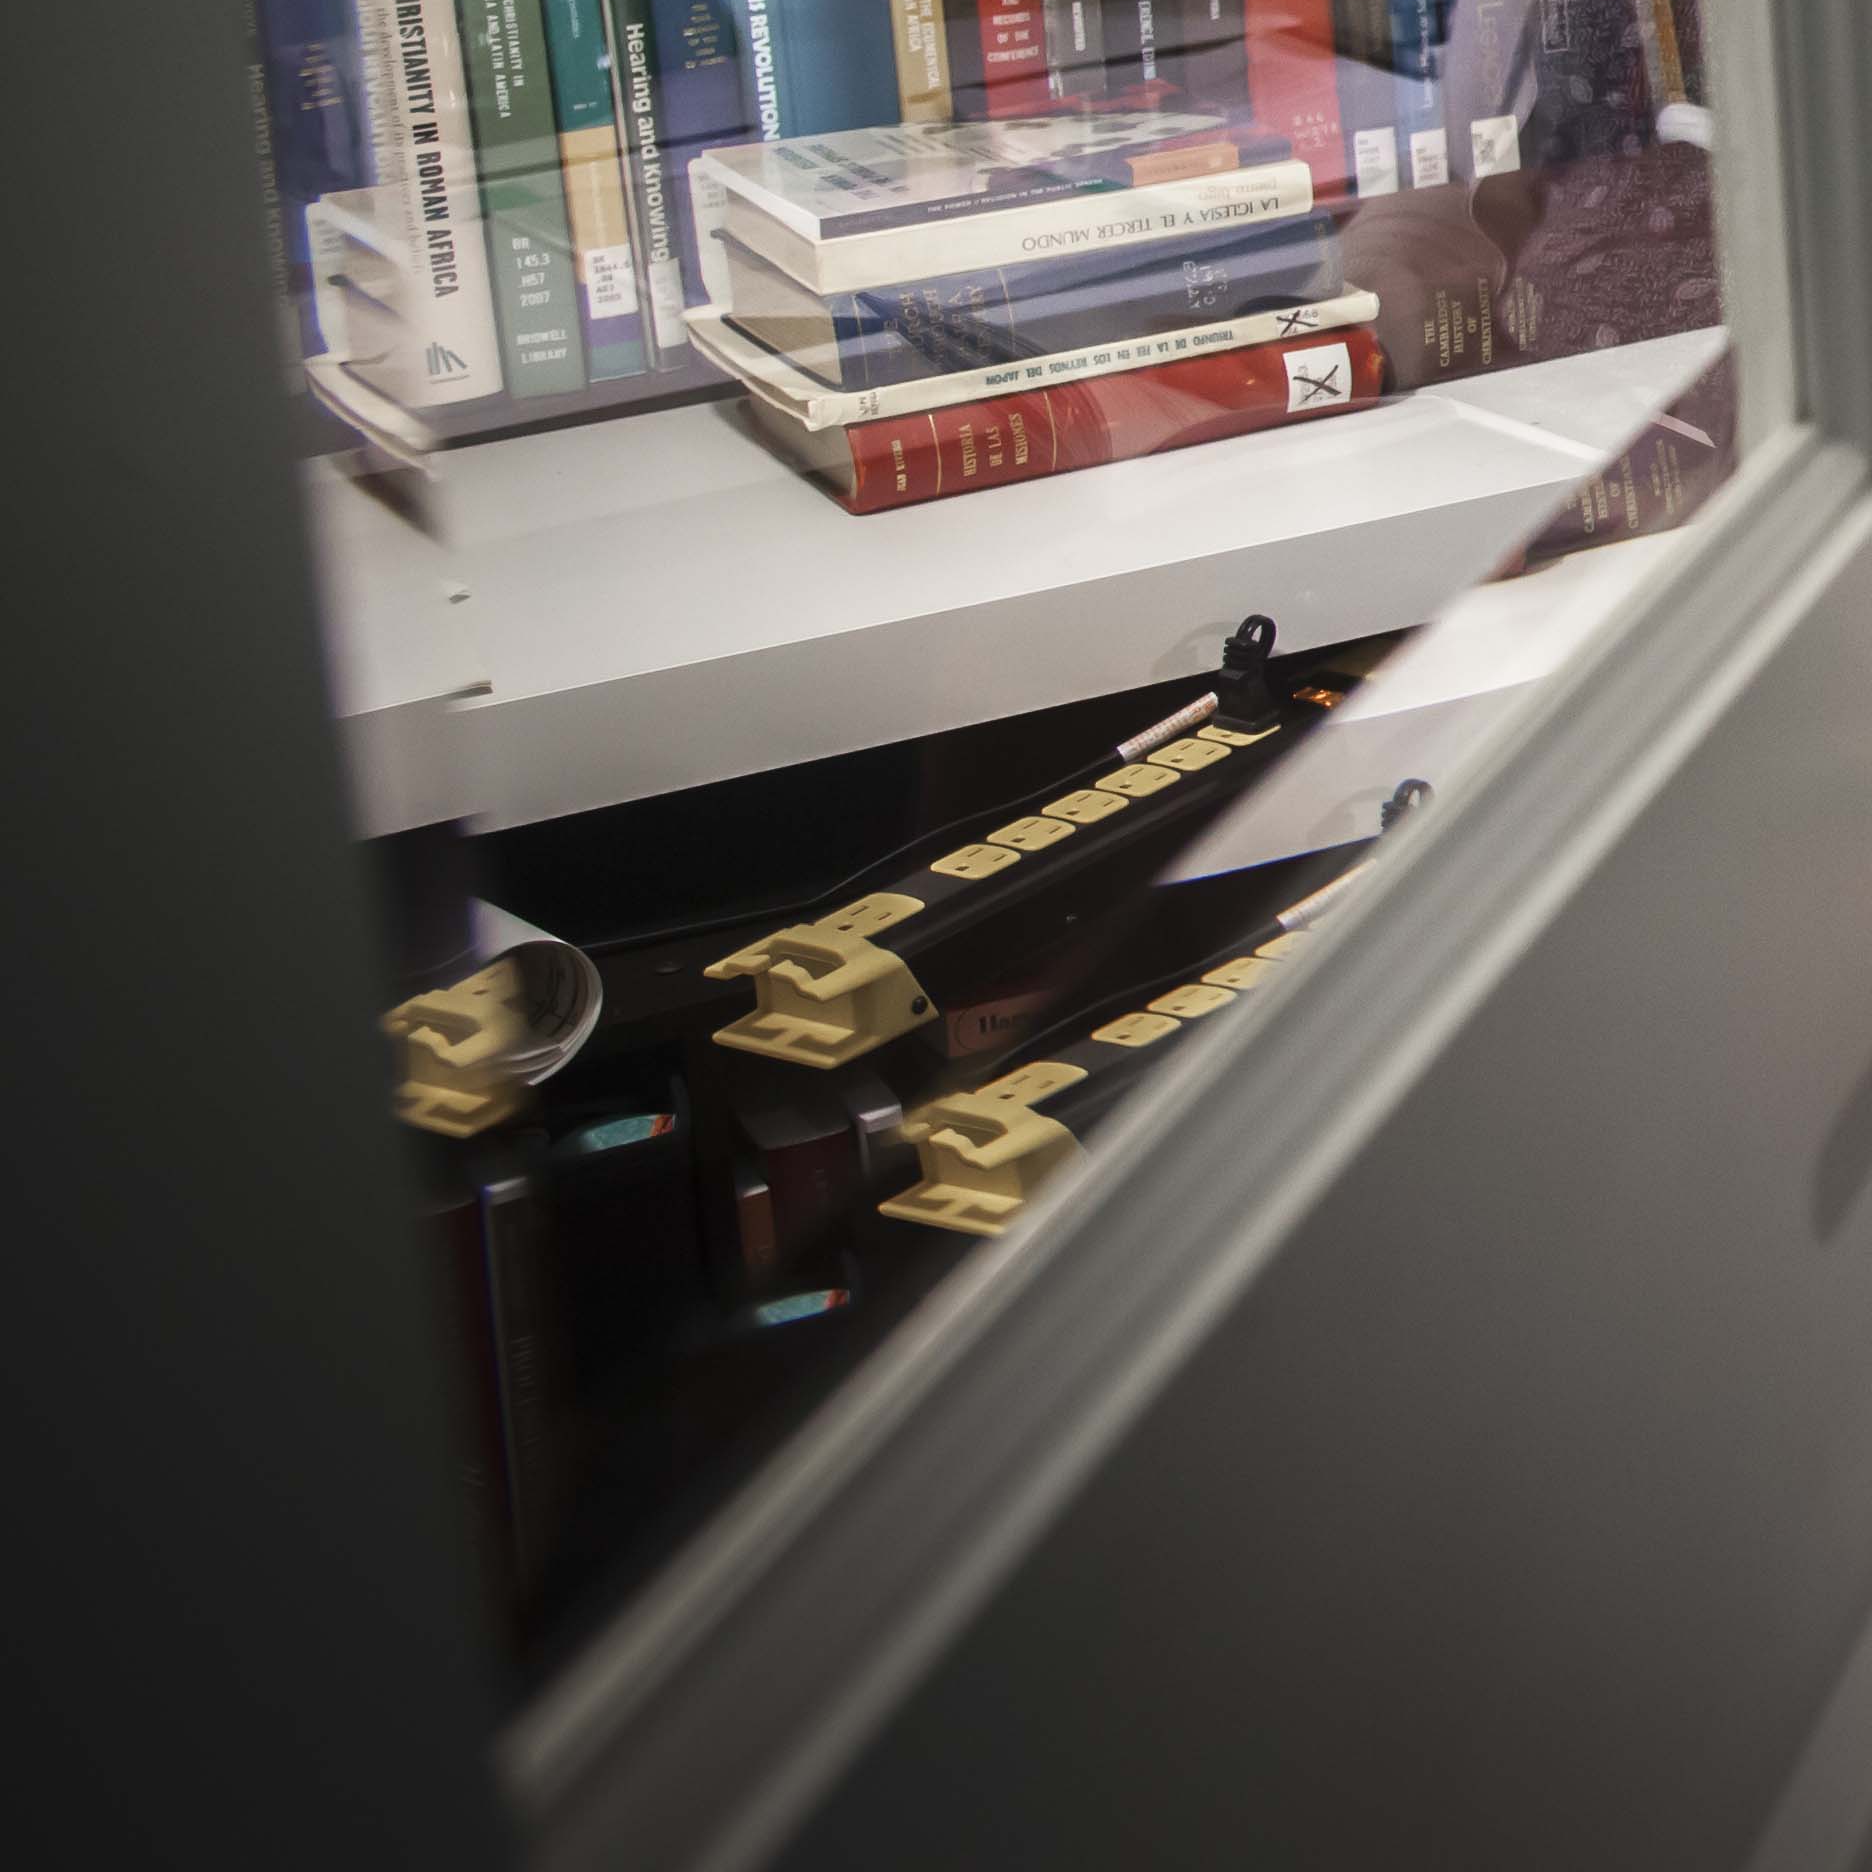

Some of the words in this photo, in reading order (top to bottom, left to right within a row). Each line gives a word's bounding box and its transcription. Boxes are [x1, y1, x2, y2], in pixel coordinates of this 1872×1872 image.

[486, 14, 501, 38] AND
[992, 12, 1032, 26] RECORDS
[906, 13, 924, 54] AFRICA
[997, 32, 1009, 44] OF
[1014, 29, 1031, 42] THE
[490, 38, 507, 70] LATIN
[923, 21, 942, 91] ECUMENICAL
[986, 45, 1040, 63] CONFERENCE
[625, 22, 654, 115] Hearing
[750, 14, 781, 143] REVOLUTION
[512, 74, 525, 88] IN
[494, 73, 513, 120] AMERICA
[412, 122, 440, 146] IN
[637, 116, 661, 160] and
[416, 151, 451, 222] ROMAN
[641, 161, 672, 265] Knowing
[1198, 201, 1255, 224] IGLESIA
[1260, 197, 1280, 212] LA
[1096, 219, 1151, 240] TERCER
[1159, 216, 1175, 230] EL
[1184, 213, 1194, 226] Y
[512, 236, 531, 251] BR
[1022, 227, 1091, 252] MUNDO
[426, 229, 460, 299] AFRICA
[515, 253, 551, 269] 145.3
[519, 291, 551, 308] 2007
[1438, 289, 1451, 368] CAMBRIDGE
[1452, 300, 1465, 354] HISTORY
[1466, 316, 1478, 334] OF
[1477, 277, 1494, 366] CHRISTIANITY
[515, 329, 568, 347] BRIDWELL
[1192, 328, 1235, 347] TRIUNFO
[1424, 319, 1436, 346] THE
[1156, 341, 1170, 353] LA
[1174, 337, 1188, 349] DE
[520, 348, 568, 365] LIBRARY
[1092, 352, 1112, 367] LOS
[1116, 348, 1131, 361] EN
[1025, 366, 1043, 379] DEL
[1048, 356, 1088, 375] REYNOS
[984, 369, 1020, 386] JAPON
[985, 425, 1003, 450] LAS
[1007, 412, 1030, 465] MISIONES
[958, 423, 978, 477] HISTORIA
[989, 453, 1004, 468] DE
